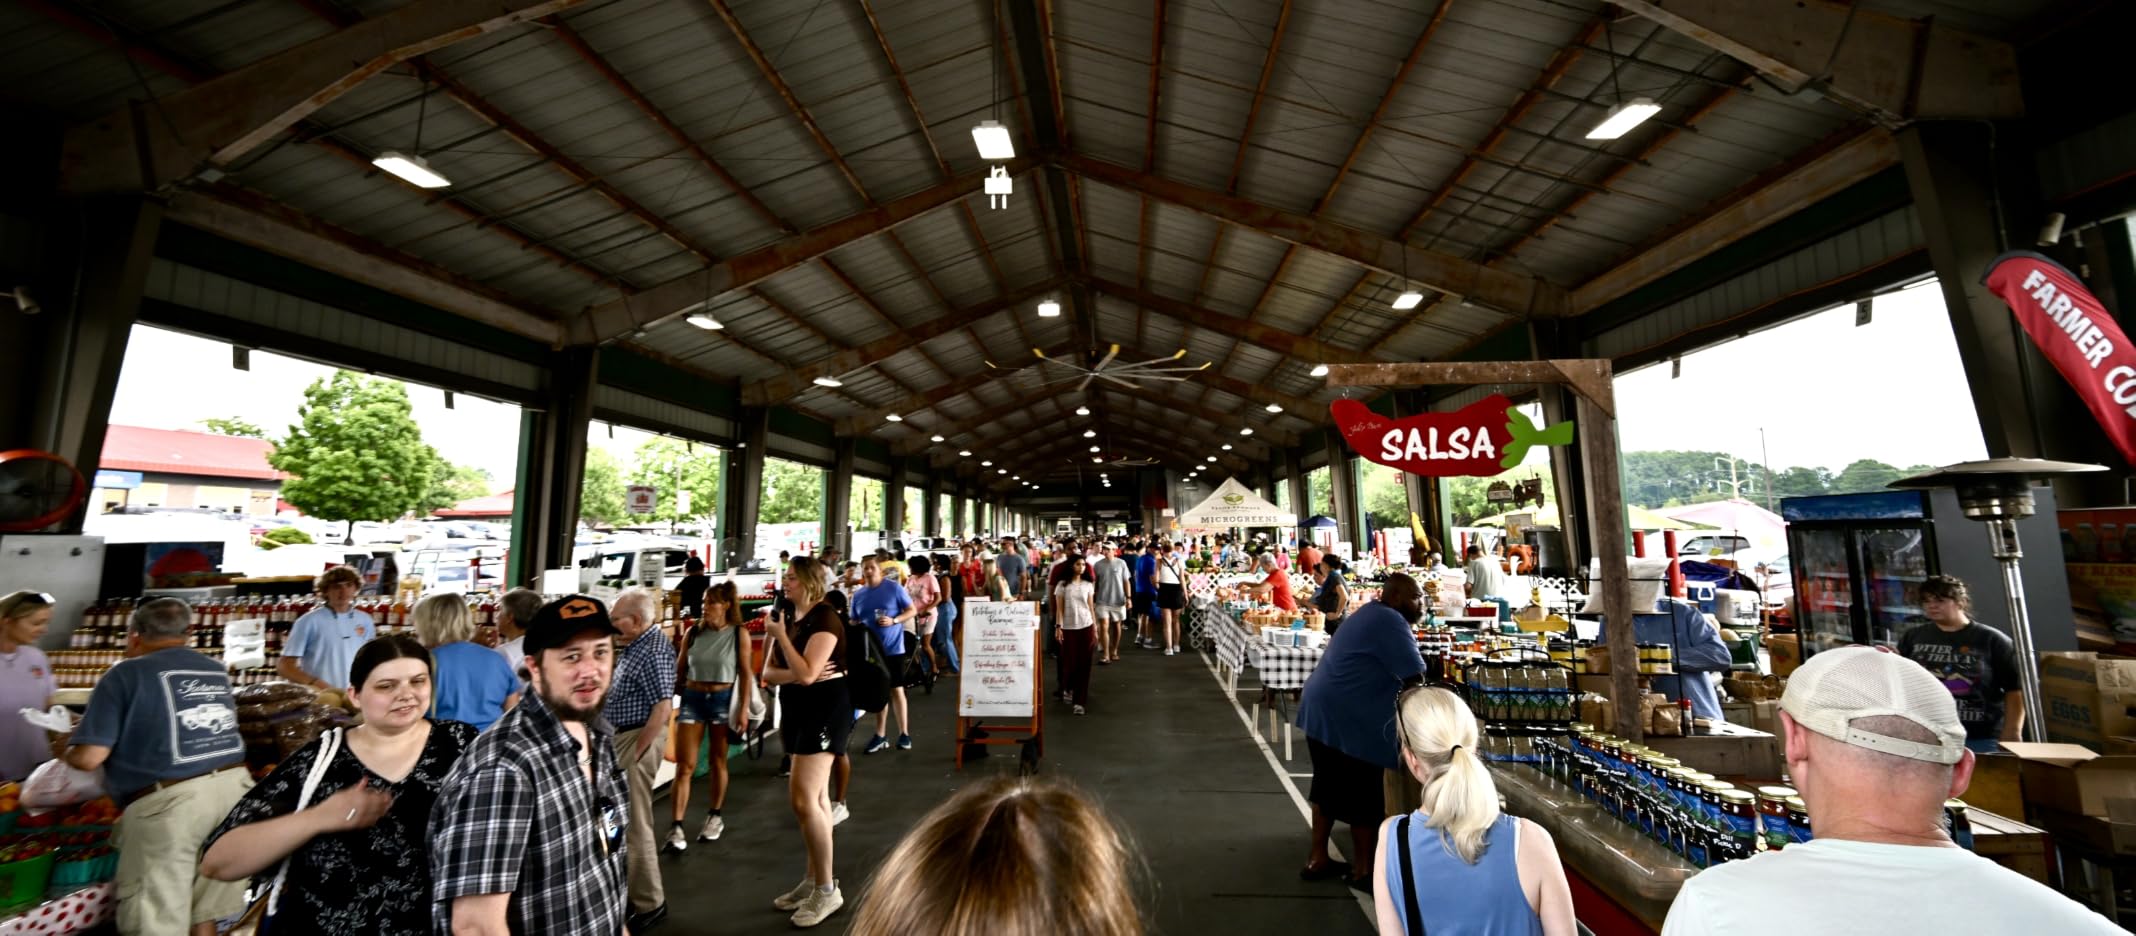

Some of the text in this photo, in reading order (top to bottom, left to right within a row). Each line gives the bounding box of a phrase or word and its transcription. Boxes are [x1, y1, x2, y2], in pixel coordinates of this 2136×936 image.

[2021, 268, 2136, 419] FARMER CO
[1381, 425, 1495, 461] SALSA
[1200, 515, 1278, 524] MICROGREENS
[2052, 699, 2090, 723] EGGS
